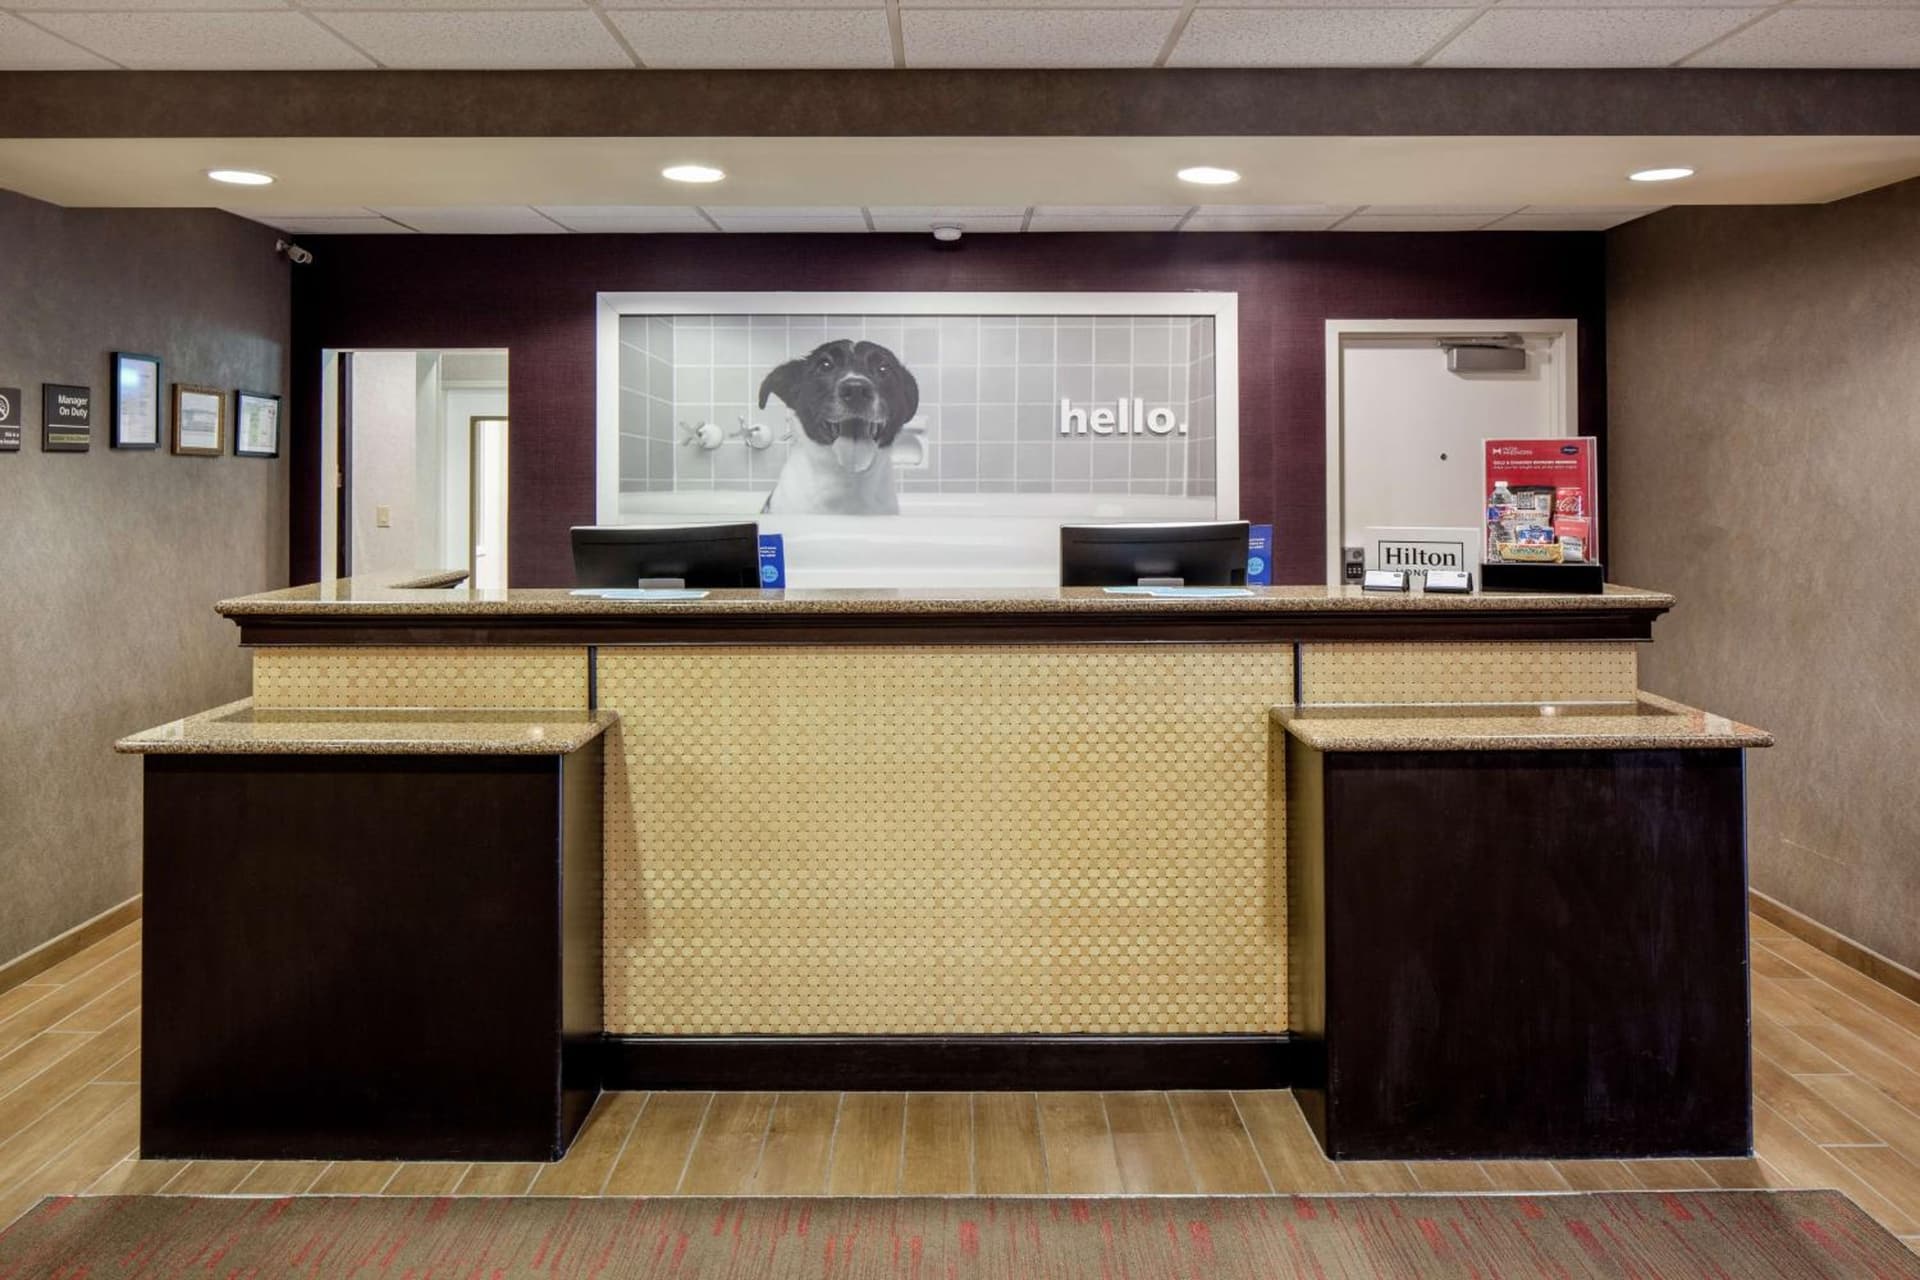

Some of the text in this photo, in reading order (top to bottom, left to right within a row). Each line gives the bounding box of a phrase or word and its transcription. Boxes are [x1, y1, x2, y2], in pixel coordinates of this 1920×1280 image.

[58, 394, 88, 408] Manager
[59, 406, 88, 419] On Duty
[1060, 398, 1187, 434] hello.
[1386, 547, 1456, 567] Hilton
